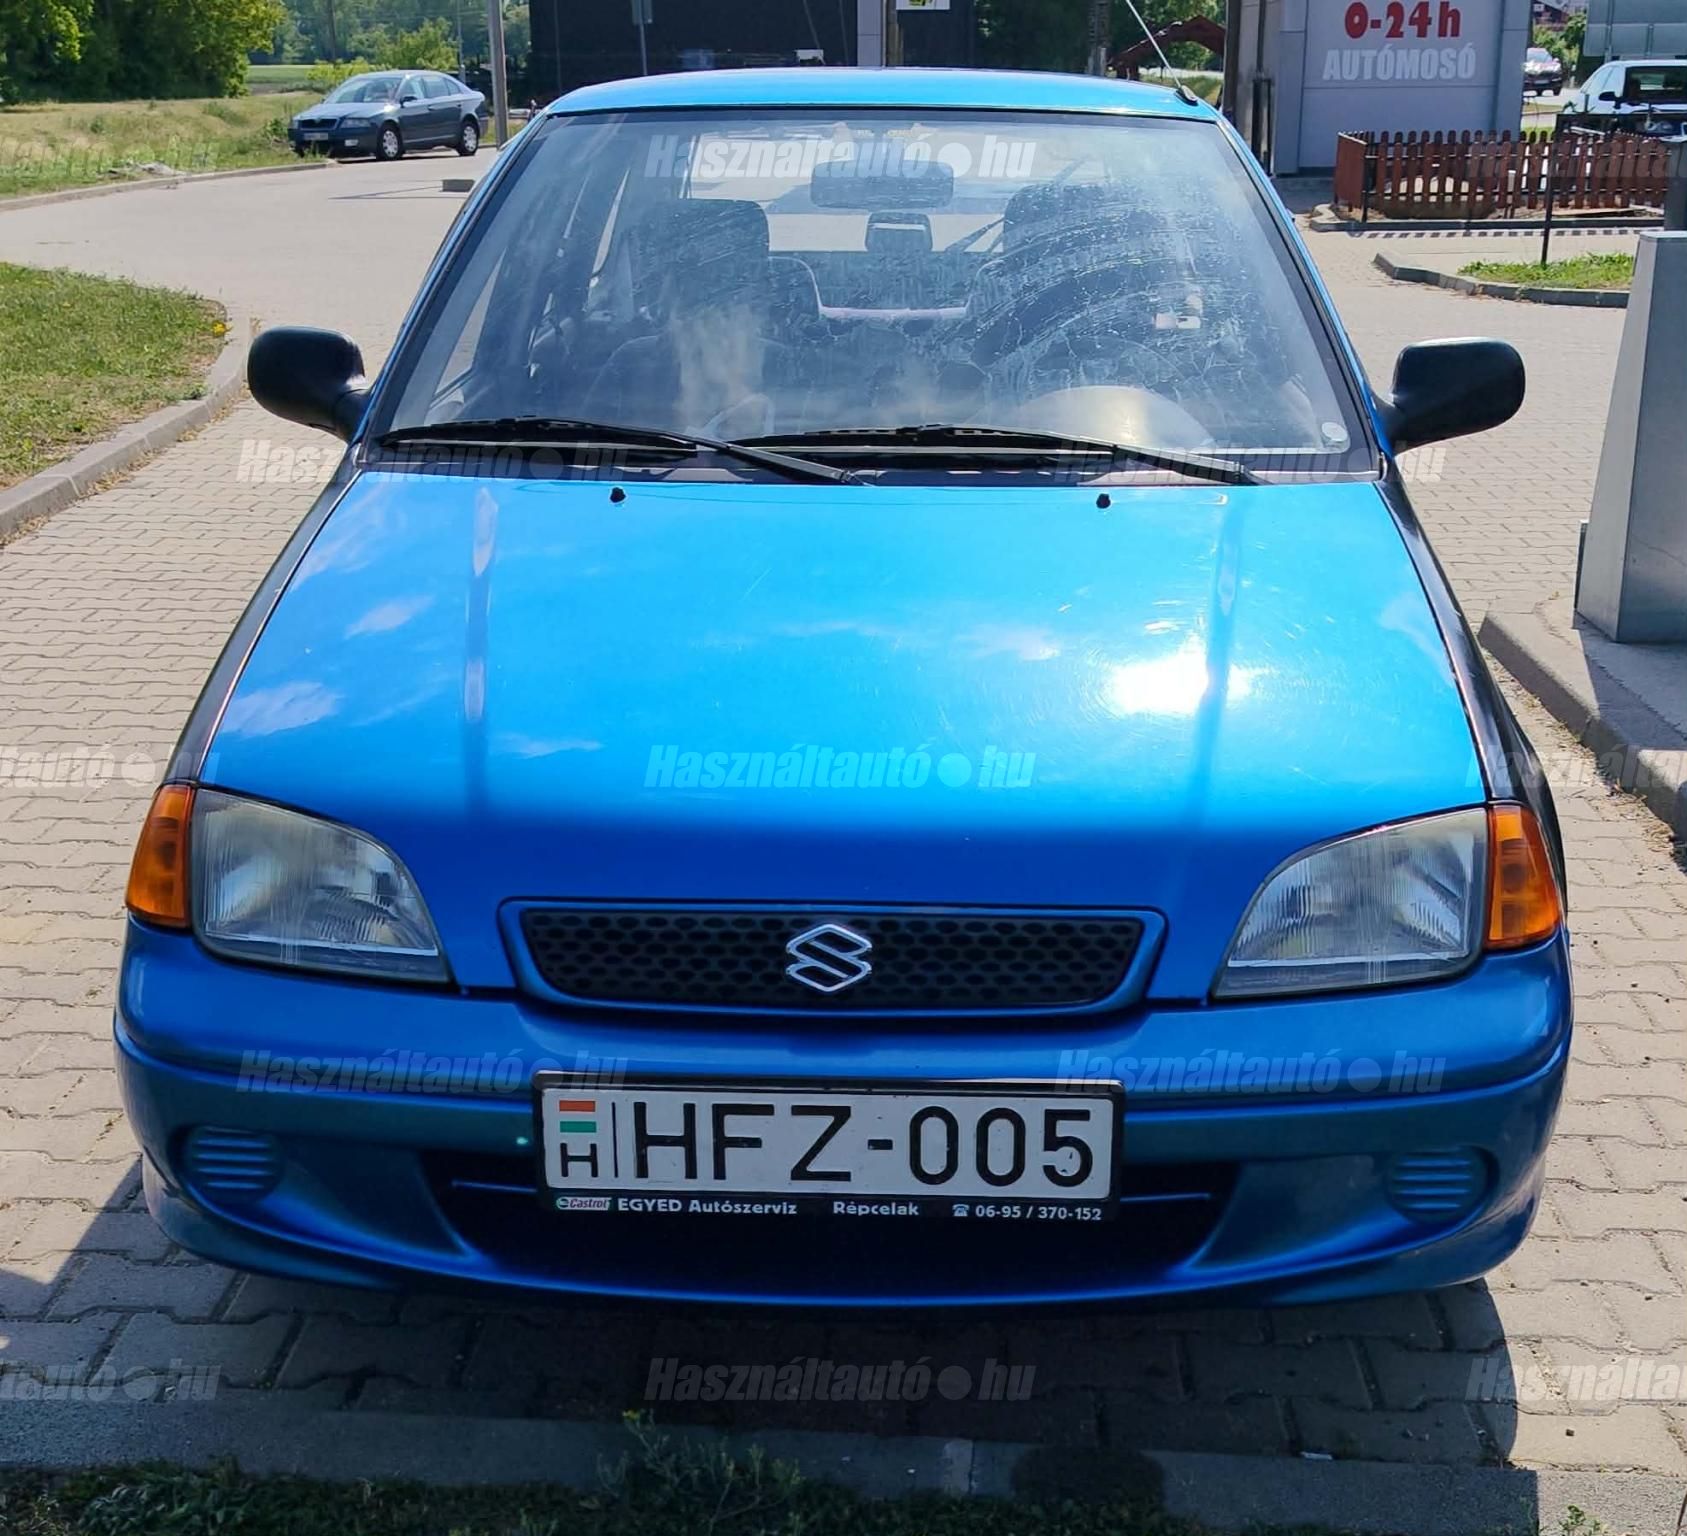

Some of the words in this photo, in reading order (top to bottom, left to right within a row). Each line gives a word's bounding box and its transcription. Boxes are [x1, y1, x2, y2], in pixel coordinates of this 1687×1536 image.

[1322, 43, 1477, 80] AUTÓMOSÓ
[560, 1143, 598, 1178] H
[634, 1101, 1094, 1187] HFZ-005
[568, 1197, 609, 1210] Castrol
[617, 1198, 682, 1212] EGYED
[688, 1199, 798, 1215] Autószerviz
[832, 1200, 919, 1216] Répcelak
[975, 1205, 1022, 1218] 06-95
[1037, 1206, 1102, 1220] 370-152
